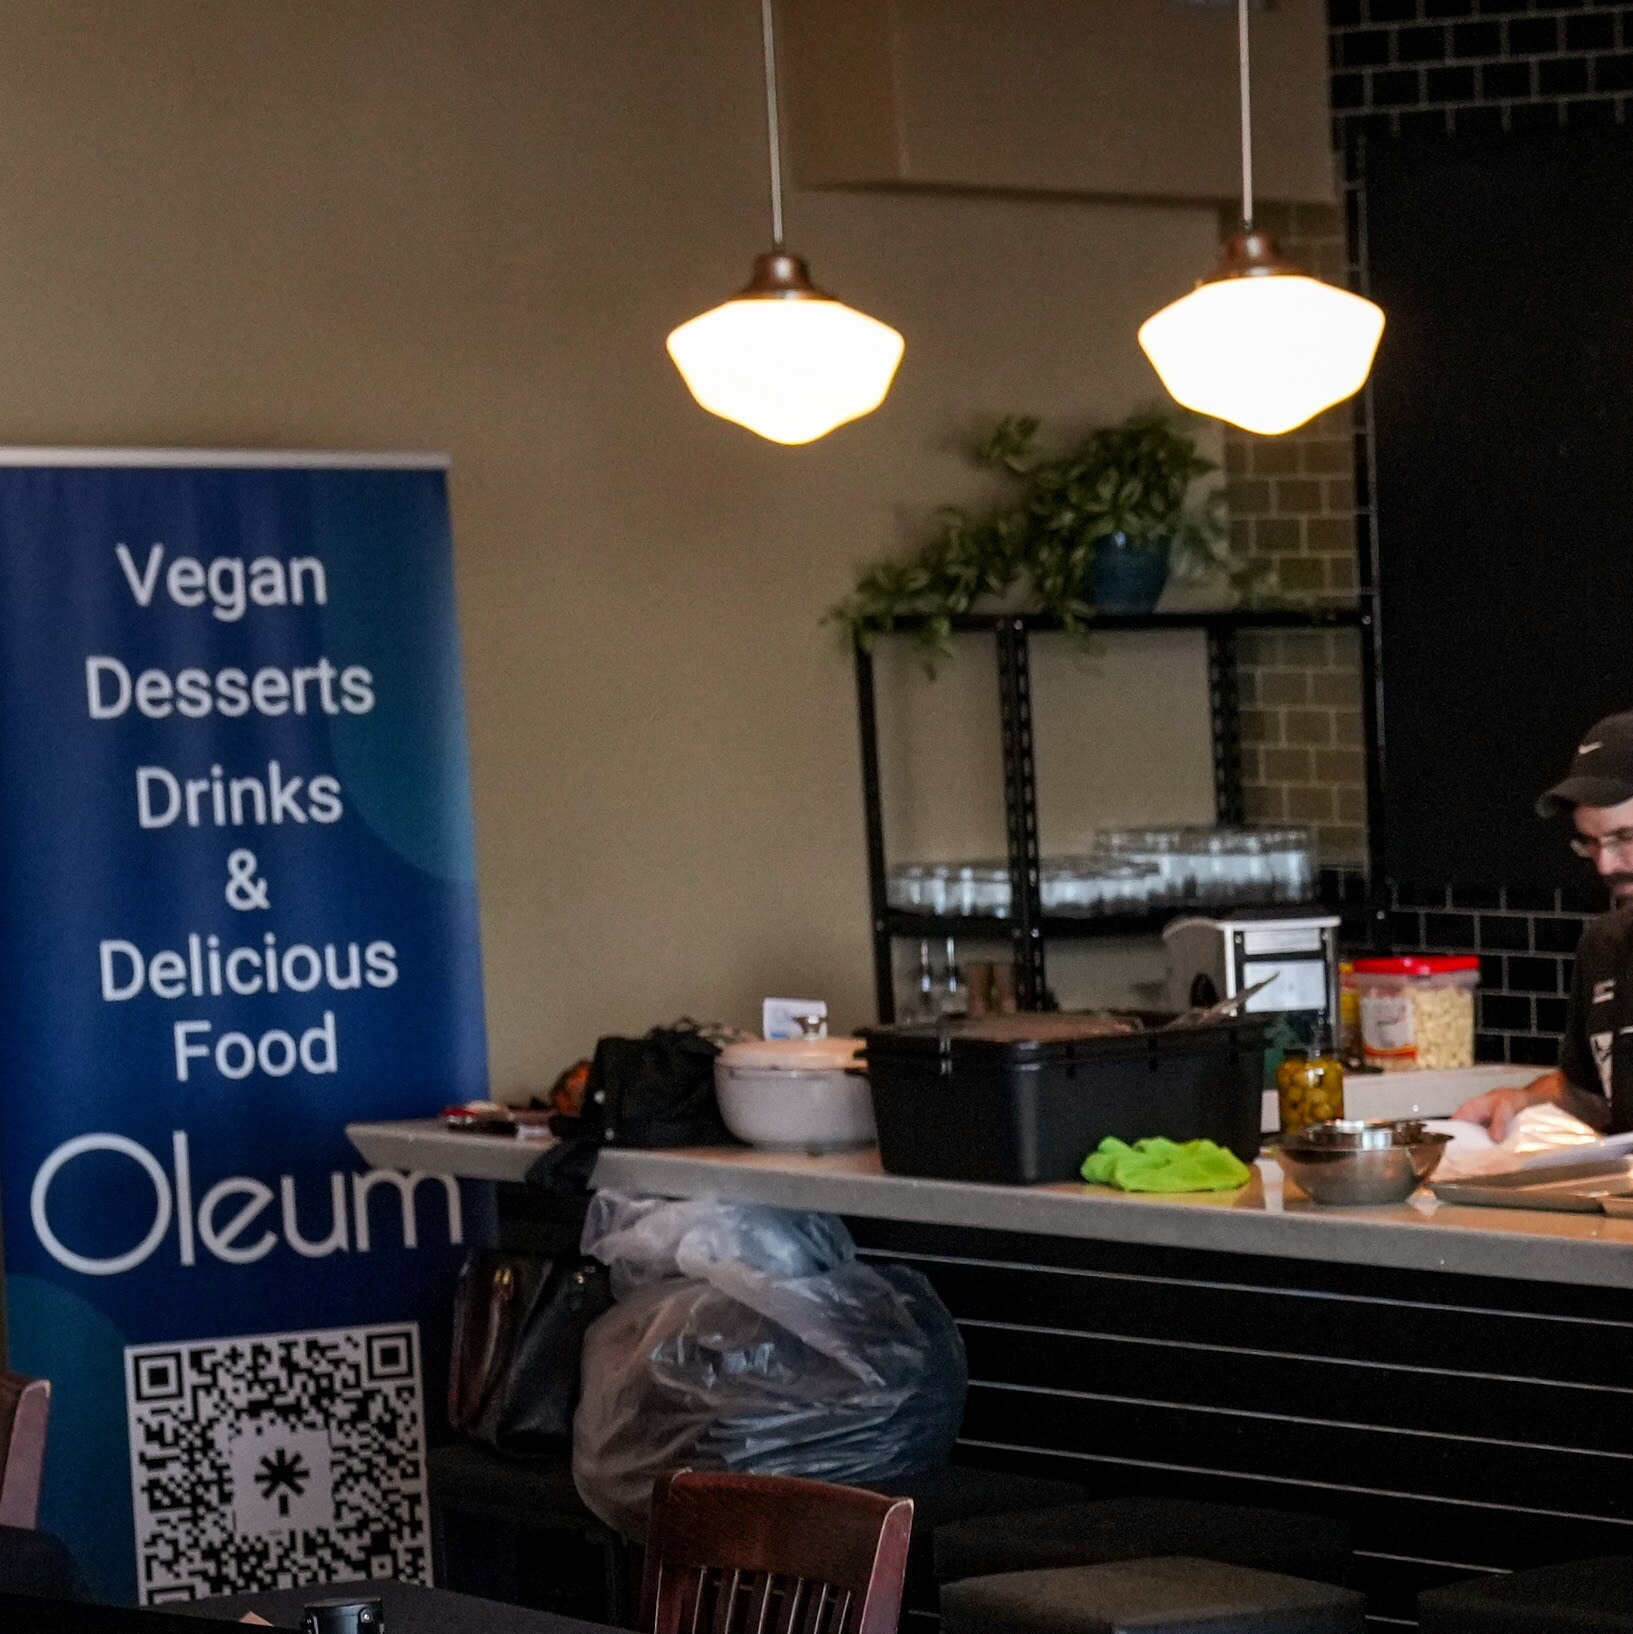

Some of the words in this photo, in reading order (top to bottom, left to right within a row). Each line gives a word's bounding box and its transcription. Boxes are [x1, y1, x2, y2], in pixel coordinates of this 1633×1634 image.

[115, 543, 328, 622] Vegan
[85, 655, 376, 720] Desserts
[135, 761, 344, 830] Drinks
[224, 849, 271, 911] &
[99, 932, 399, 1003] Delicious
[173, 1012, 339, 1082] Food
[29, 1130, 463, 1276] Oleum
